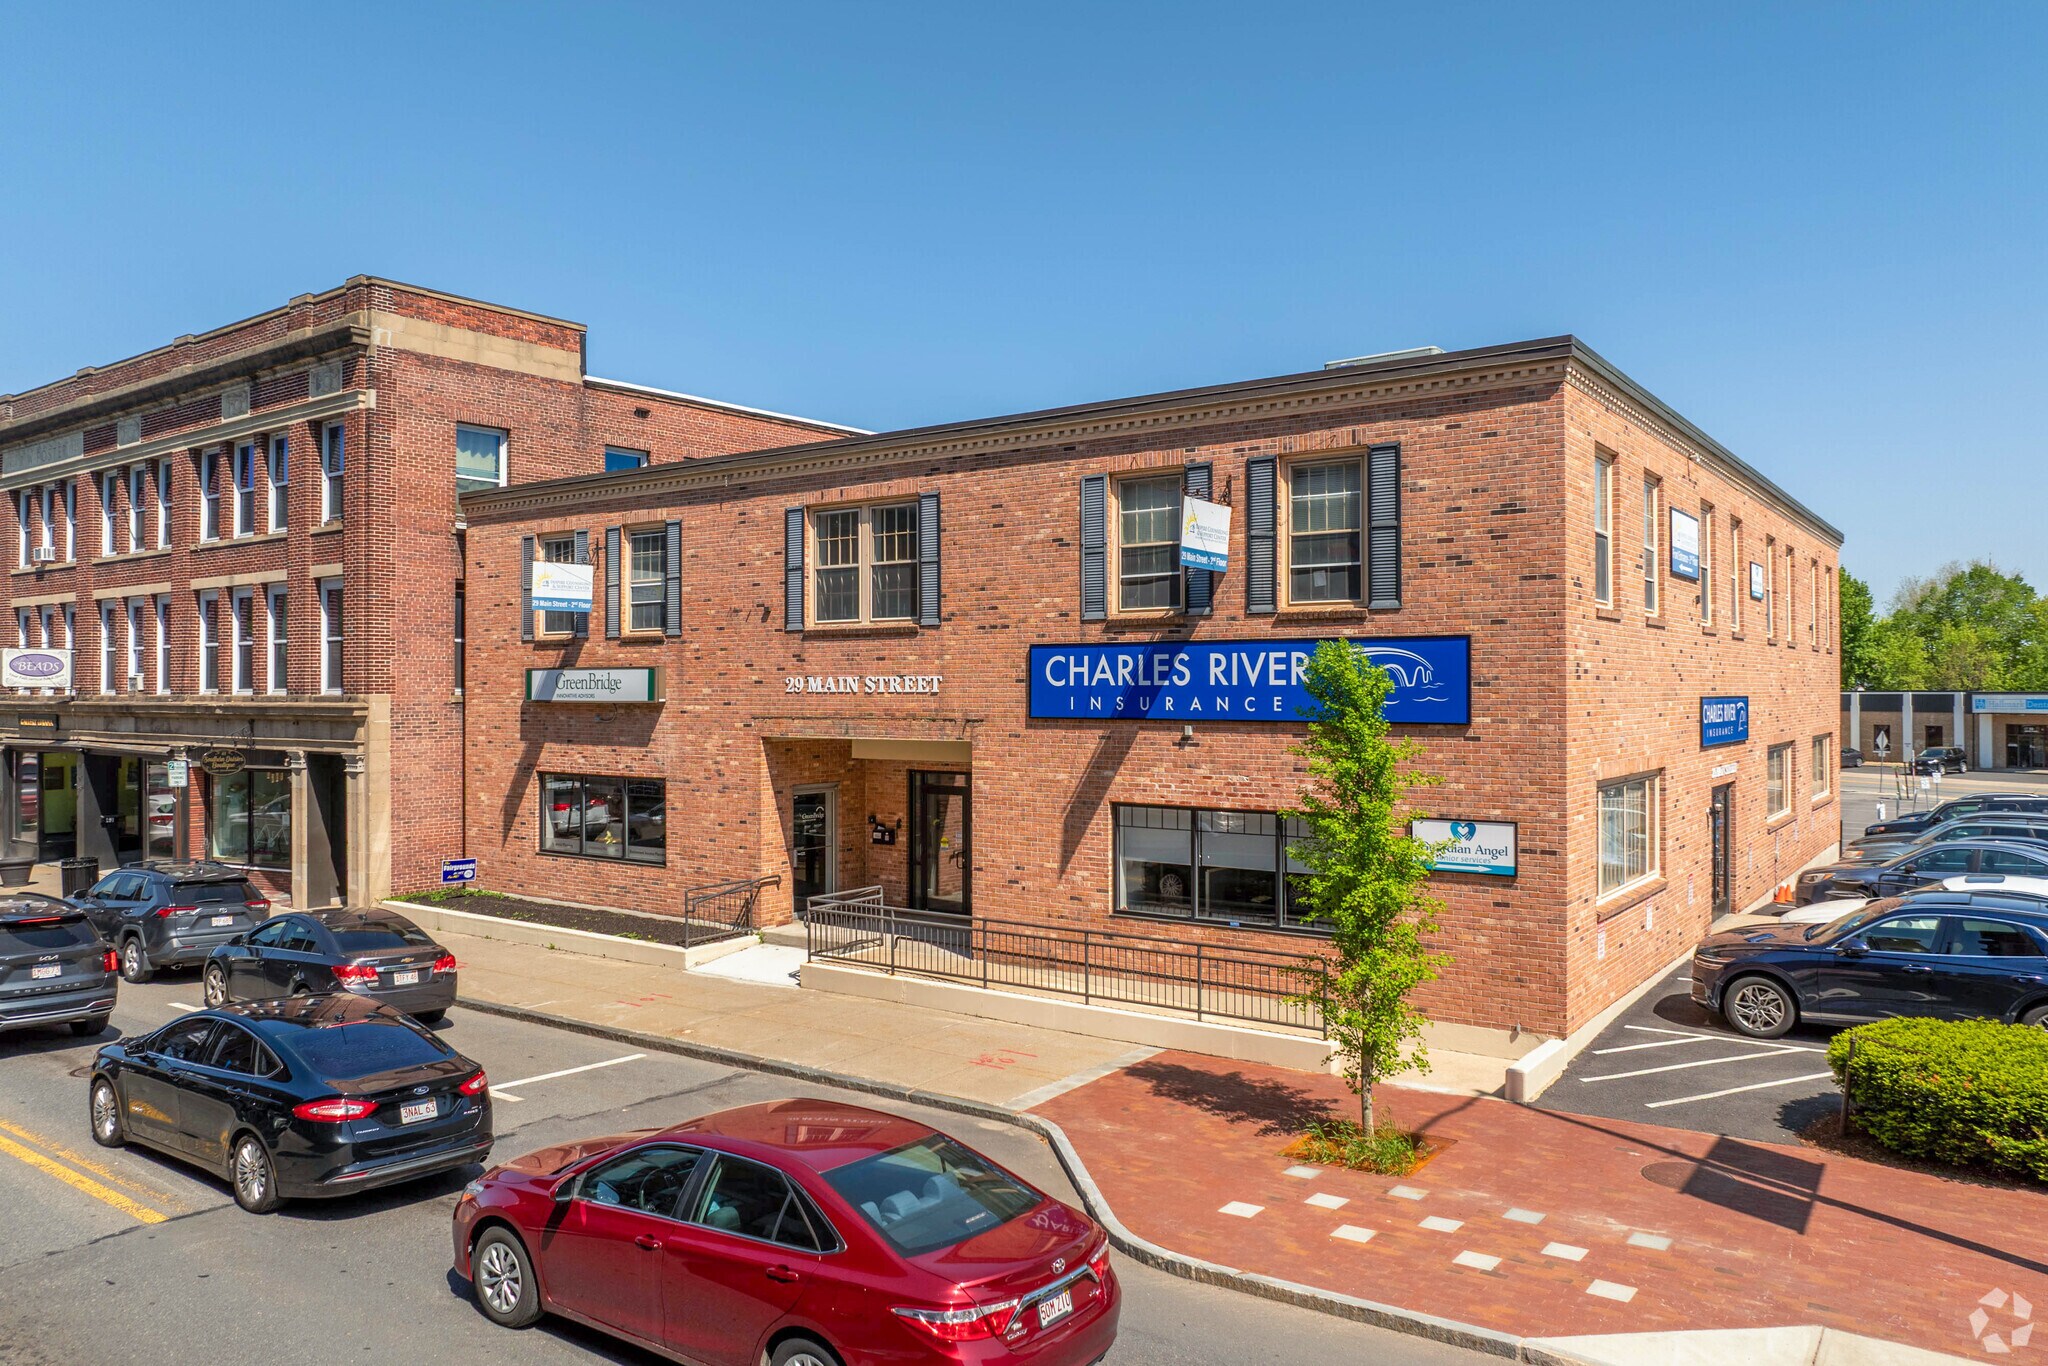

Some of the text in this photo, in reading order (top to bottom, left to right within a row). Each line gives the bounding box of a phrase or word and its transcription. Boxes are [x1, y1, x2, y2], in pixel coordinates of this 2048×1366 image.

[1187, 553, 1196, 562] Main
[1196, 554, 1208, 564] Street
[1216, 557, 1227, 567] Floor
[553, 600, 568, 608] Street
[18, 661, 60, 672] BEADS
[1045, 650, 1311, 687] CHARLES RIVER
[555, 672, 622, 694] GreenBridge
[785, 675, 943, 694] 29 MAIN STREET
[1069, 695, 1283, 712] INSURANCE
[1703, 703, 1736, 724] CHARLES RIVER
[1706, 726, 1734, 738] INSURANCE
[1461, 856, 1492, 864] services
[1475, 844, 1509, 861] Angel
[403, 1102, 436, 1118] 3NAL 63
